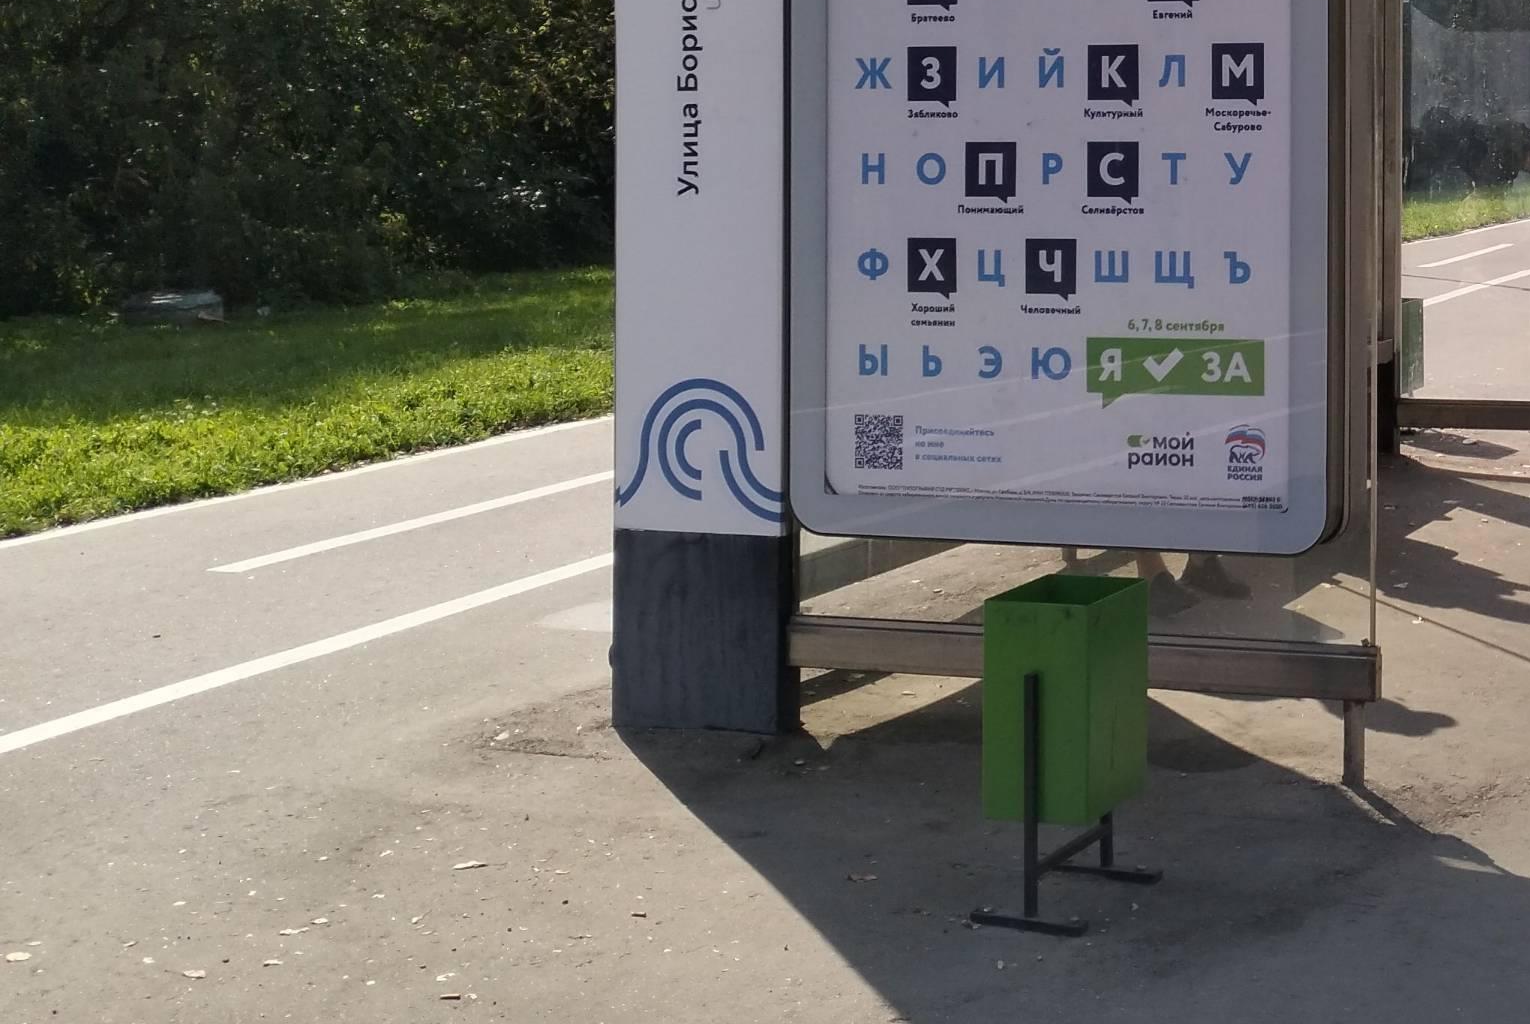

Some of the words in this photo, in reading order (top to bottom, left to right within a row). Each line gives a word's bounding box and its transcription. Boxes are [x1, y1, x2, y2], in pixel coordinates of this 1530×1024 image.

[1152, 9, 1193, 20] Евгений
[855, 58, 891, 88] Ж
[920, 57, 940, 89] З
[979, 57, 1005, 88] И
[1038, 49, 1064, 88] Й
[1102, 55, 1126, 88] К
[1158, 55, 1186, 87] Л
[1222, 54, 1254, 86] М
[1083, 108, 1144, 118] Культурный
[1214, 122, 1262, 133] Сабурово
[678, 104, 702, 196] Улица
[862, 154, 885, 184] Н
[916, 153, 946, 184] О
[978, 154, 1003, 184] П
[1043, 154, 1063, 184] Р
[1099, 153, 1126, 184] С
[1162, 154, 1186, 184] Т
[1224, 153, 1252, 185] У
[957, 204, 1024, 215] Понимающий
[1081, 205, 1145, 216] Селивёрстов
[857, 248, 889, 280] Ф
[918, 249, 944, 280] Х
[978, 250, 1005, 286] Ц
[1039, 250, 1061, 282] Ч
[1095, 251, 1128, 283] Ш
[1155, 251, 1194, 288] Щ
[1224, 251, 1251, 284] Ъ
[911, 303, 955, 314] Хороший
[1020, 305, 1081, 315] Человечный
[911, 319, 955, 327] семьянин
[1127, 319, 1140, 332] 6,
[1155, 319, 1163, 331] 8
[1166, 320, 1225, 334] сентября
[859, 344, 887, 376] Ы
[922, 346, 942, 377] Ь
[978, 346, 1002, 378] Э
[1032, 347, 1071, 380] Ю
[1098, 348, 1122, 382] Я
[1200, 351, 1252, 383] ЗА
